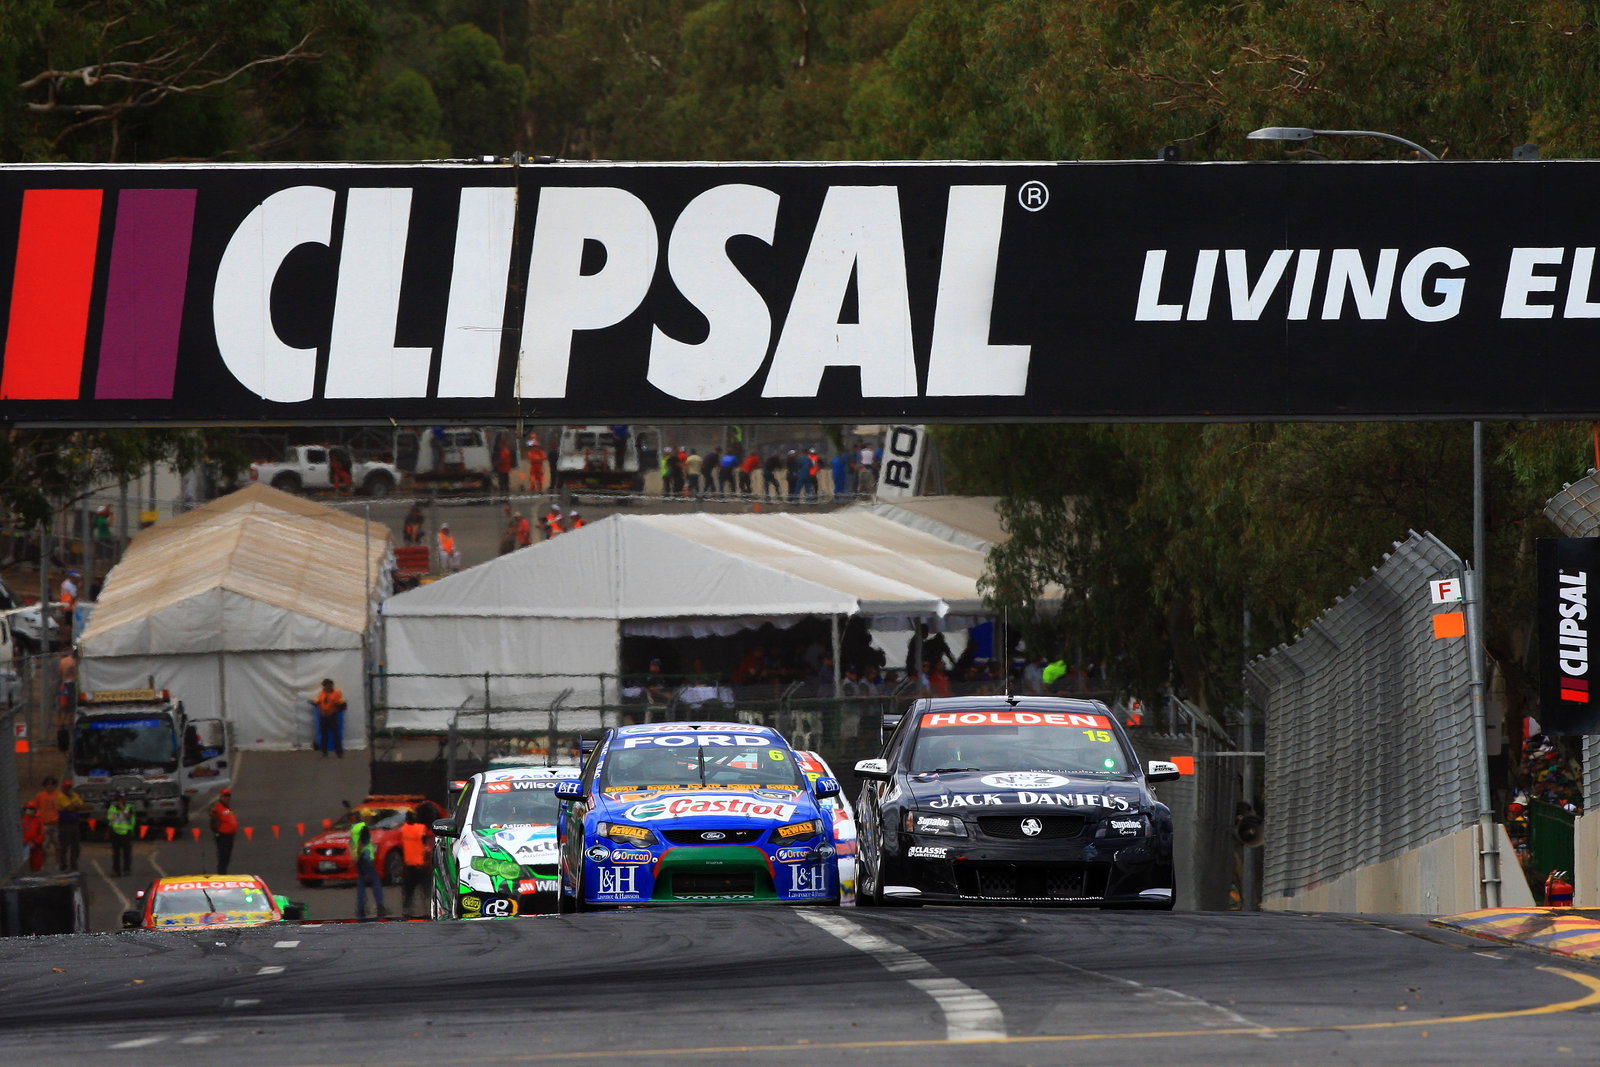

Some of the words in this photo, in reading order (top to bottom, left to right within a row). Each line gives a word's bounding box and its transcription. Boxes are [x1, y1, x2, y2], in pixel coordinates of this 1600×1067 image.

[1134, 246, 1470, 323] LIVING
[213, 183, 1031, 403] CLIPSAL
[1438, 581, 1452, 600] F
[1558, 571, 1588, 677] CLIPSAL
[929, 712, 1098, 727] HOLDEN
[15, 724, 26, 736] F
[1082, 729, 1111, 743] 15
[624, 734, 771, 749] FORD
[768, 750, 785, 761] 6
[513, 781, 557, 790] Wilso
[669, 799, 784, 817] Castrol
[930, 793, 1003, 809] JACK
[917, 816, 950, 827] Supaloc
[621, 851, 649, 861] Orrcon
[915, 846, 947, 855] CLASSIC
[597, 865, 640, 894] L&H
[788, 863, 826, 891] L&H
[164, 881, 255, 891] HOLDEN
